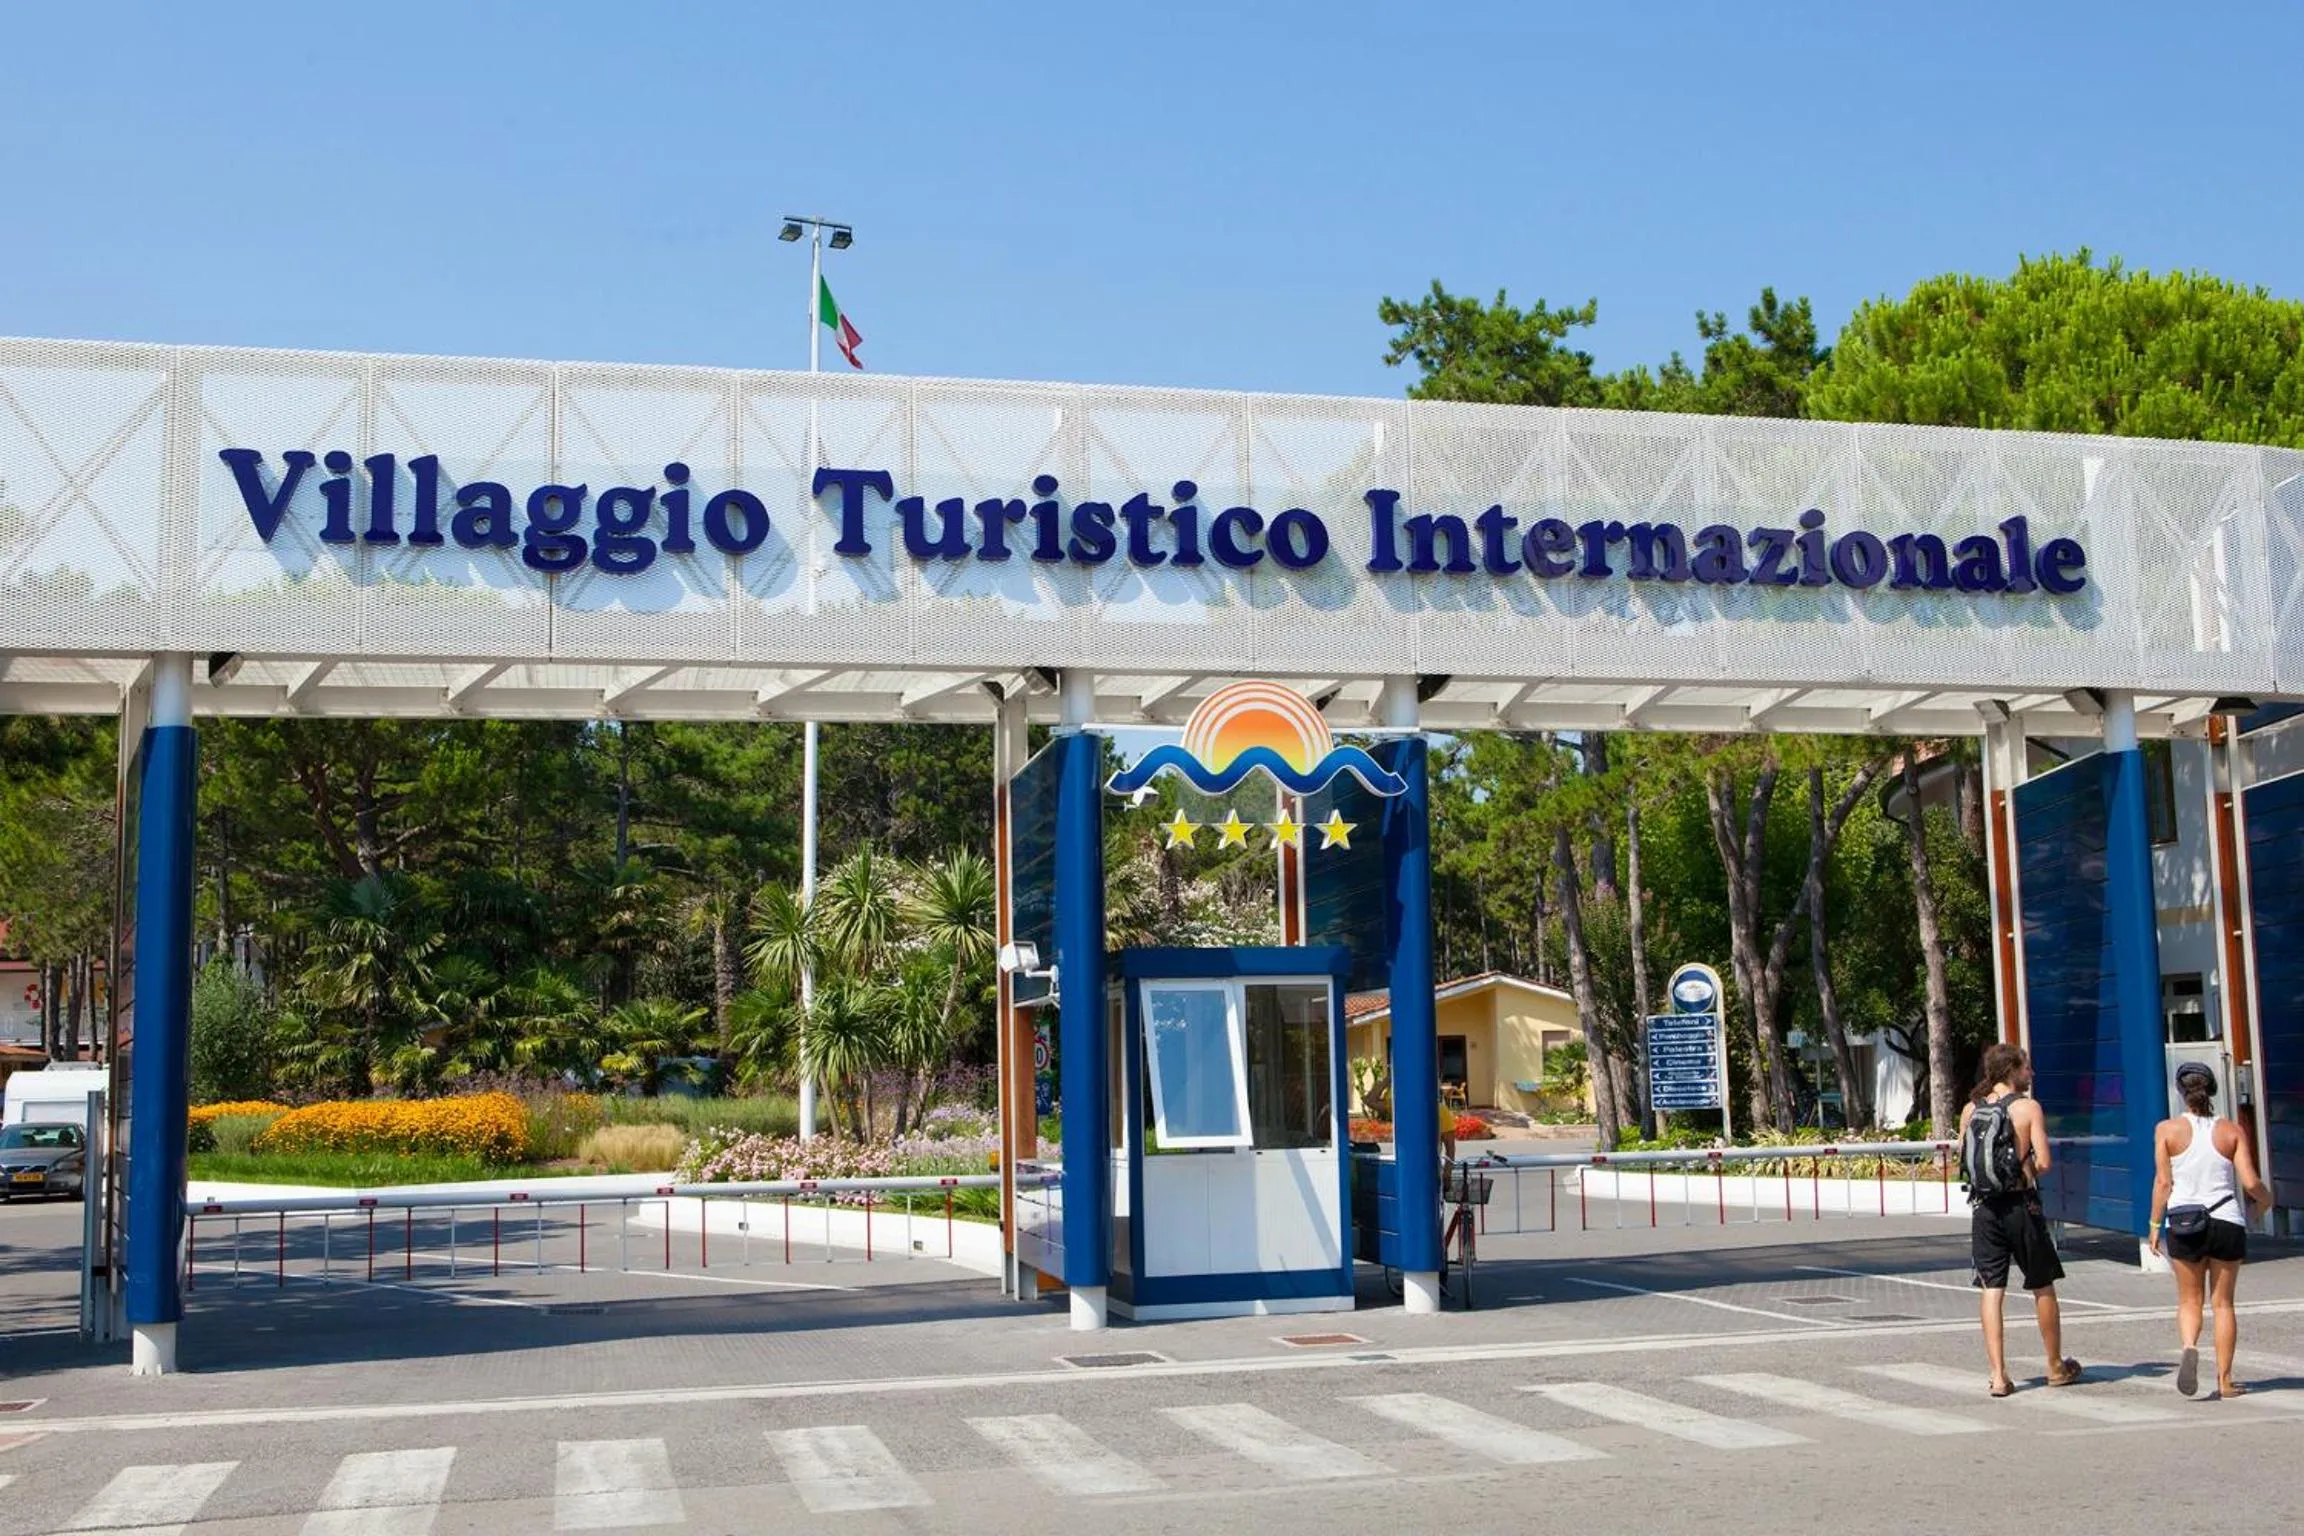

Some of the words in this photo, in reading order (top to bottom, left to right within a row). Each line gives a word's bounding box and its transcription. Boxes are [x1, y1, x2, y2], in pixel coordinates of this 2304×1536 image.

[219, 448, 770, 574] Villaggio
[812, 467, 1329, 570] Turistico
[1364, 489, 2087, 594] Internazionale
[1663, 1018, 1700, 1026] Telefoni
